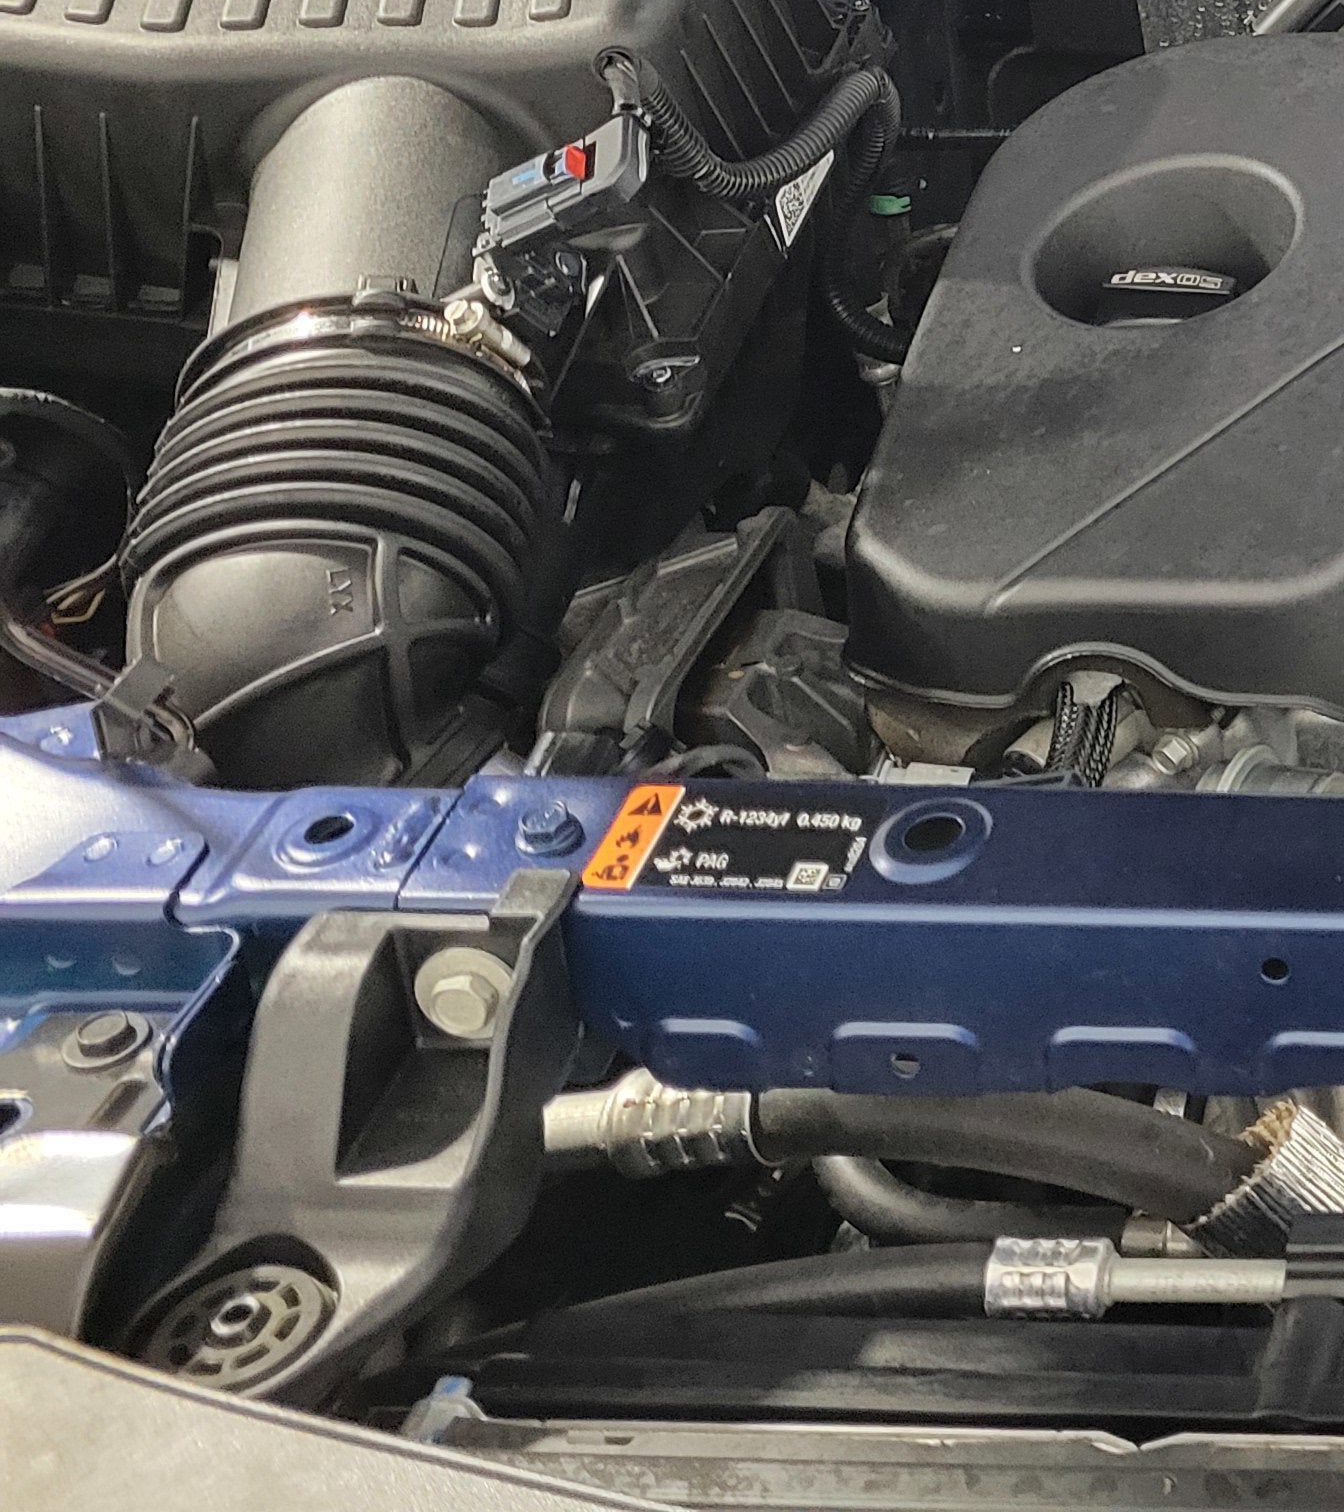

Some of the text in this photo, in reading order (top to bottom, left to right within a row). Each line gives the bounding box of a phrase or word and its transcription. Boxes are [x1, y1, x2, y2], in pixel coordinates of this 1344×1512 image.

[1110, 269, 1223, 290] dexos
[796, 812, 840, 830] 0.450
[841, 815, 863, 832] kg
[695, 851, 730, 870] PAG
